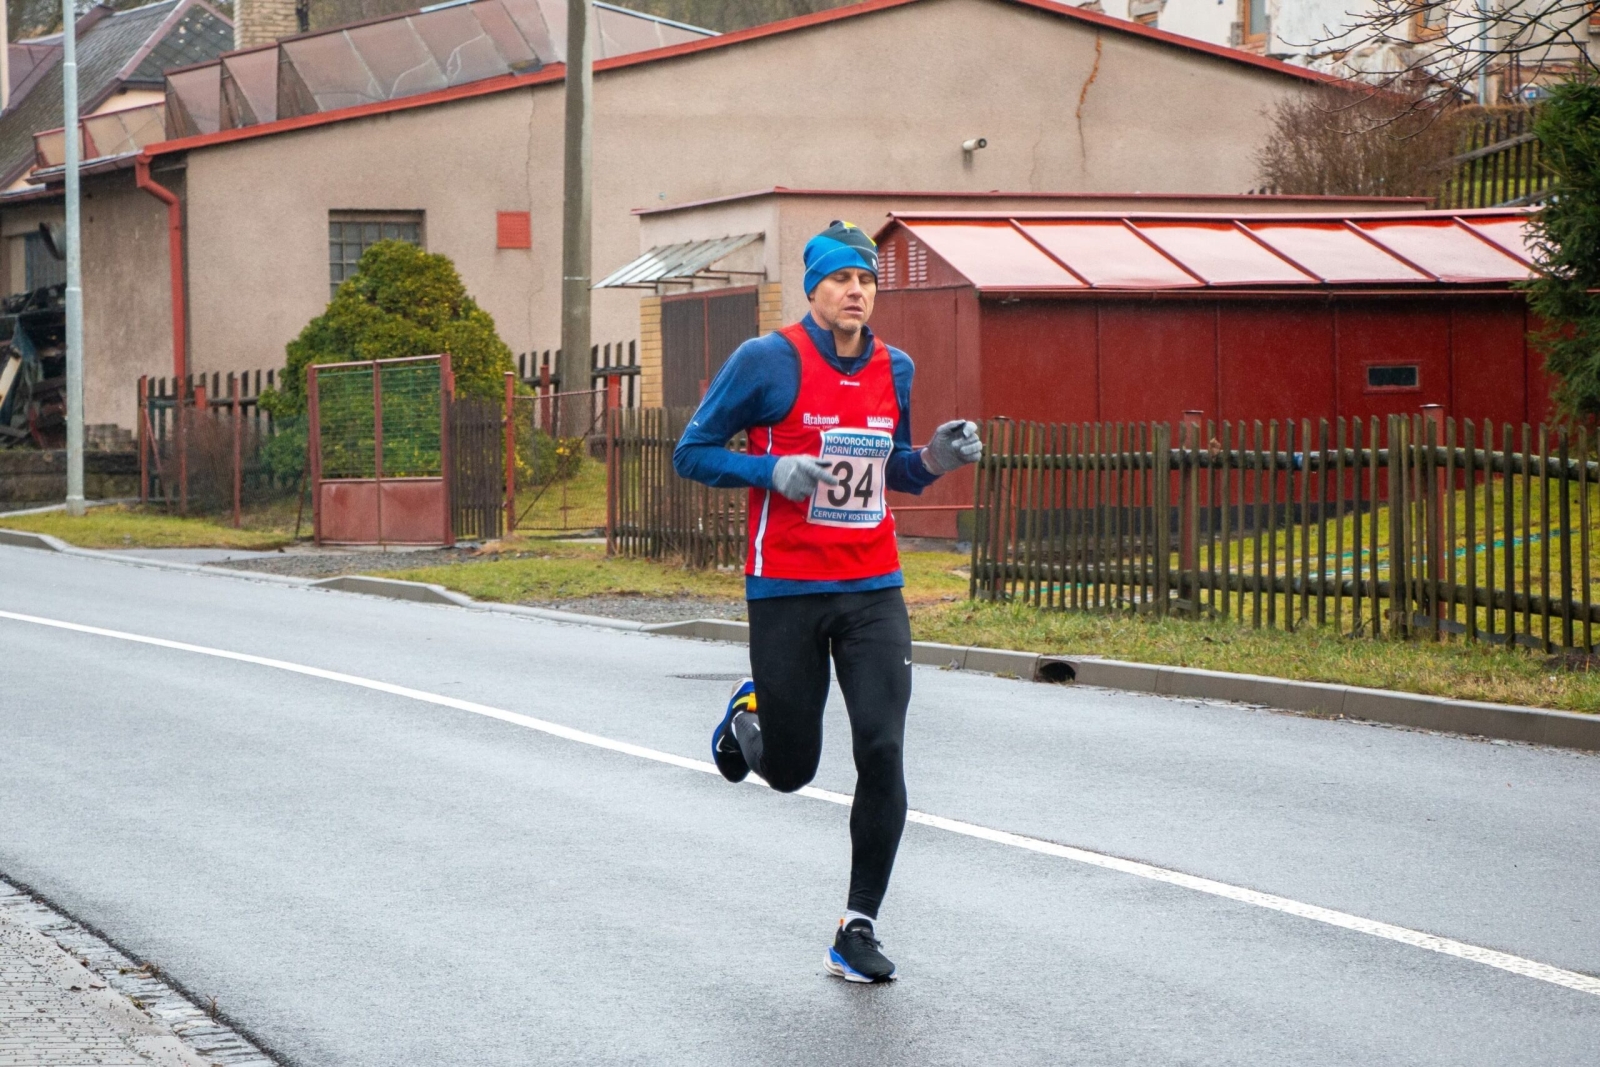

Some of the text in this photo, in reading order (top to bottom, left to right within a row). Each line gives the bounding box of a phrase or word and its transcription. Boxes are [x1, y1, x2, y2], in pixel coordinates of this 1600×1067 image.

[826, 435, 890, 448] NOVOROČNÍ BĚH
[825, 445, 889, 457] HORNÍ KOSTELEC
[827, 461, 874, 508] 34
[813, 509, 882, 521] ČERVENÝ KOSTELEC
